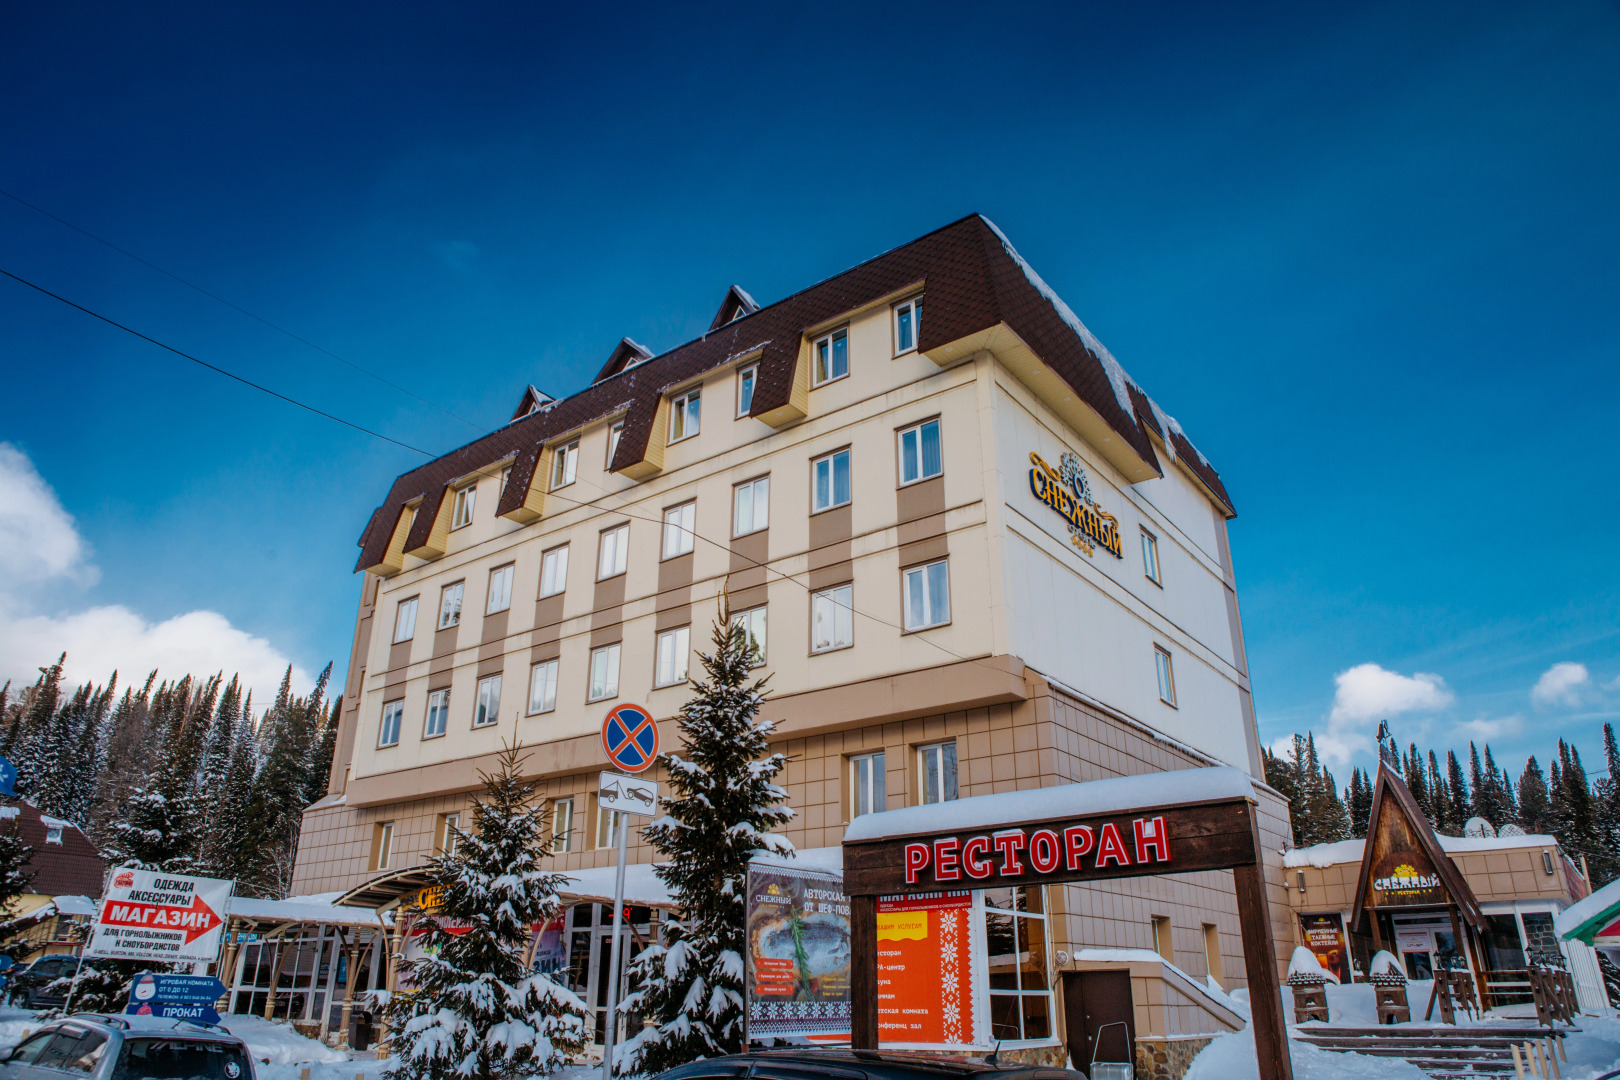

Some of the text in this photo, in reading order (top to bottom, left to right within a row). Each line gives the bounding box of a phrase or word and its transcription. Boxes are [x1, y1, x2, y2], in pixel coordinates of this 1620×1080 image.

[1030, 467, 1124, 559] СНЕЖНЫЙ
[904, 816, 1171, 884] РЕСТОРАН
[154, 878, 194, 892] ОДЕЖДА
[1374, 872, 1440, 890] СНЕЖНЫЙ
[128, 890, 191, 906] АКСЕССУАРЫ
[756, 894, 791, 904] СНЕЖНЫЙ
[803, 888, 845, 902] АВТОРСКАЯ
[804, 902, 814, 912] ОТ
[110, 905, 210, 928] МАГАЗИН
[103, 928, 182, 940] ДЛЯ ГОРНОЛЫЖНИКОВ
[122, 940, 180, 951] СНОУБОРДИСТОВ
[162, 1007, 204, 1018] ПРОКАТ
